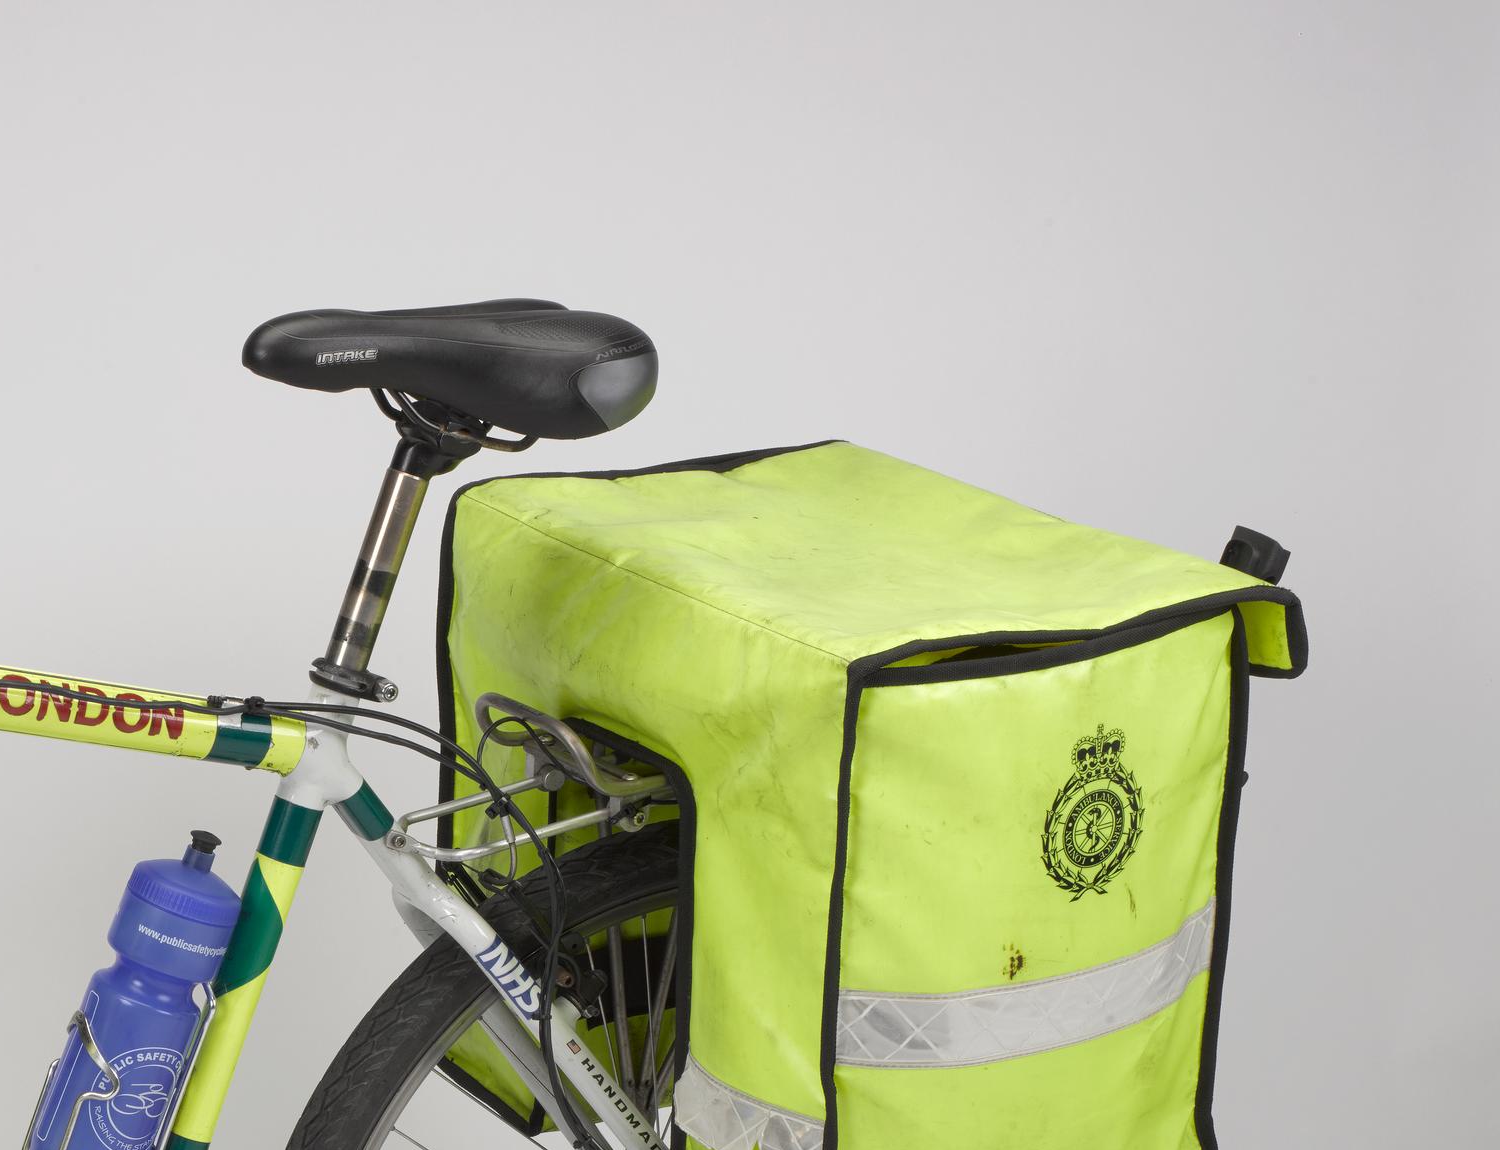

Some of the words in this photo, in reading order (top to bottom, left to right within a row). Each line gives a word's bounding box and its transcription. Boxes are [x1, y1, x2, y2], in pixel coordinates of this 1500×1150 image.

[316, 348, 379, 366] INTAKE
[1071, 790, 1121, 822] AMBULANCE
[479, 942, 543, 1015] NHS
[98, 1056, 134, 1091] PULIC
[136, 1052, 178, 1066] SAFETY
[94, 1105, 117, 1145] RAISING
[116, 1140, 133, 1150] THE
